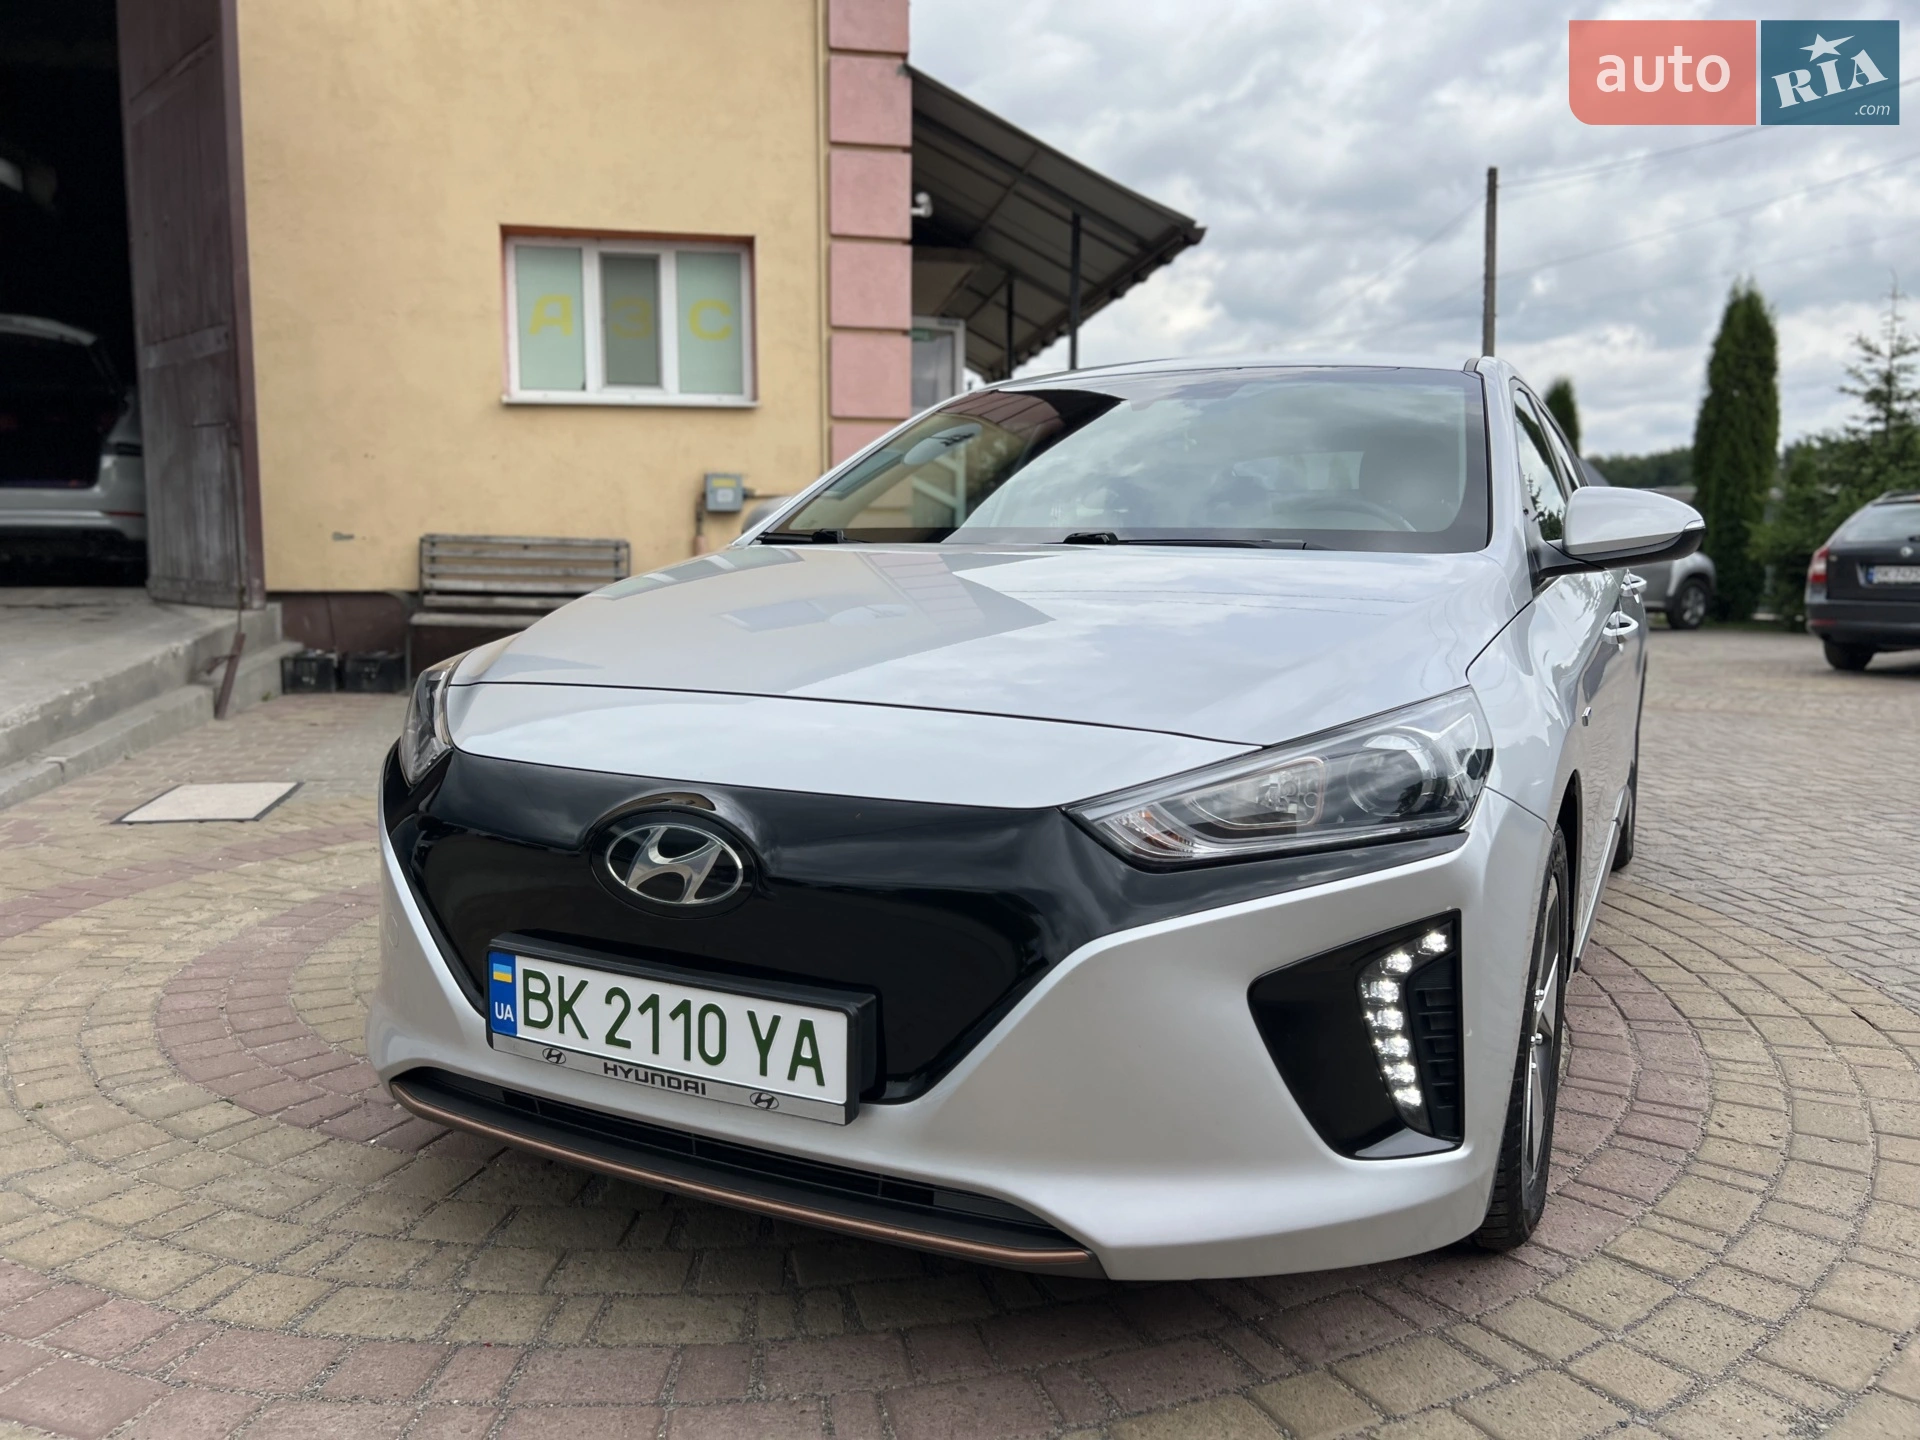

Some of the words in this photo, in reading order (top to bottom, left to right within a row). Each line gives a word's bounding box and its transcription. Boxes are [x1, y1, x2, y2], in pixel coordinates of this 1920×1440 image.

[495, 1001, 515, 1023] UA
[522, 967, 590, 1040] BK
[604, 986, 727, 1066] 2110
[746, 1009, 826, 1088] YA
[603, 1061, 707, 1096] HYUNDAI
